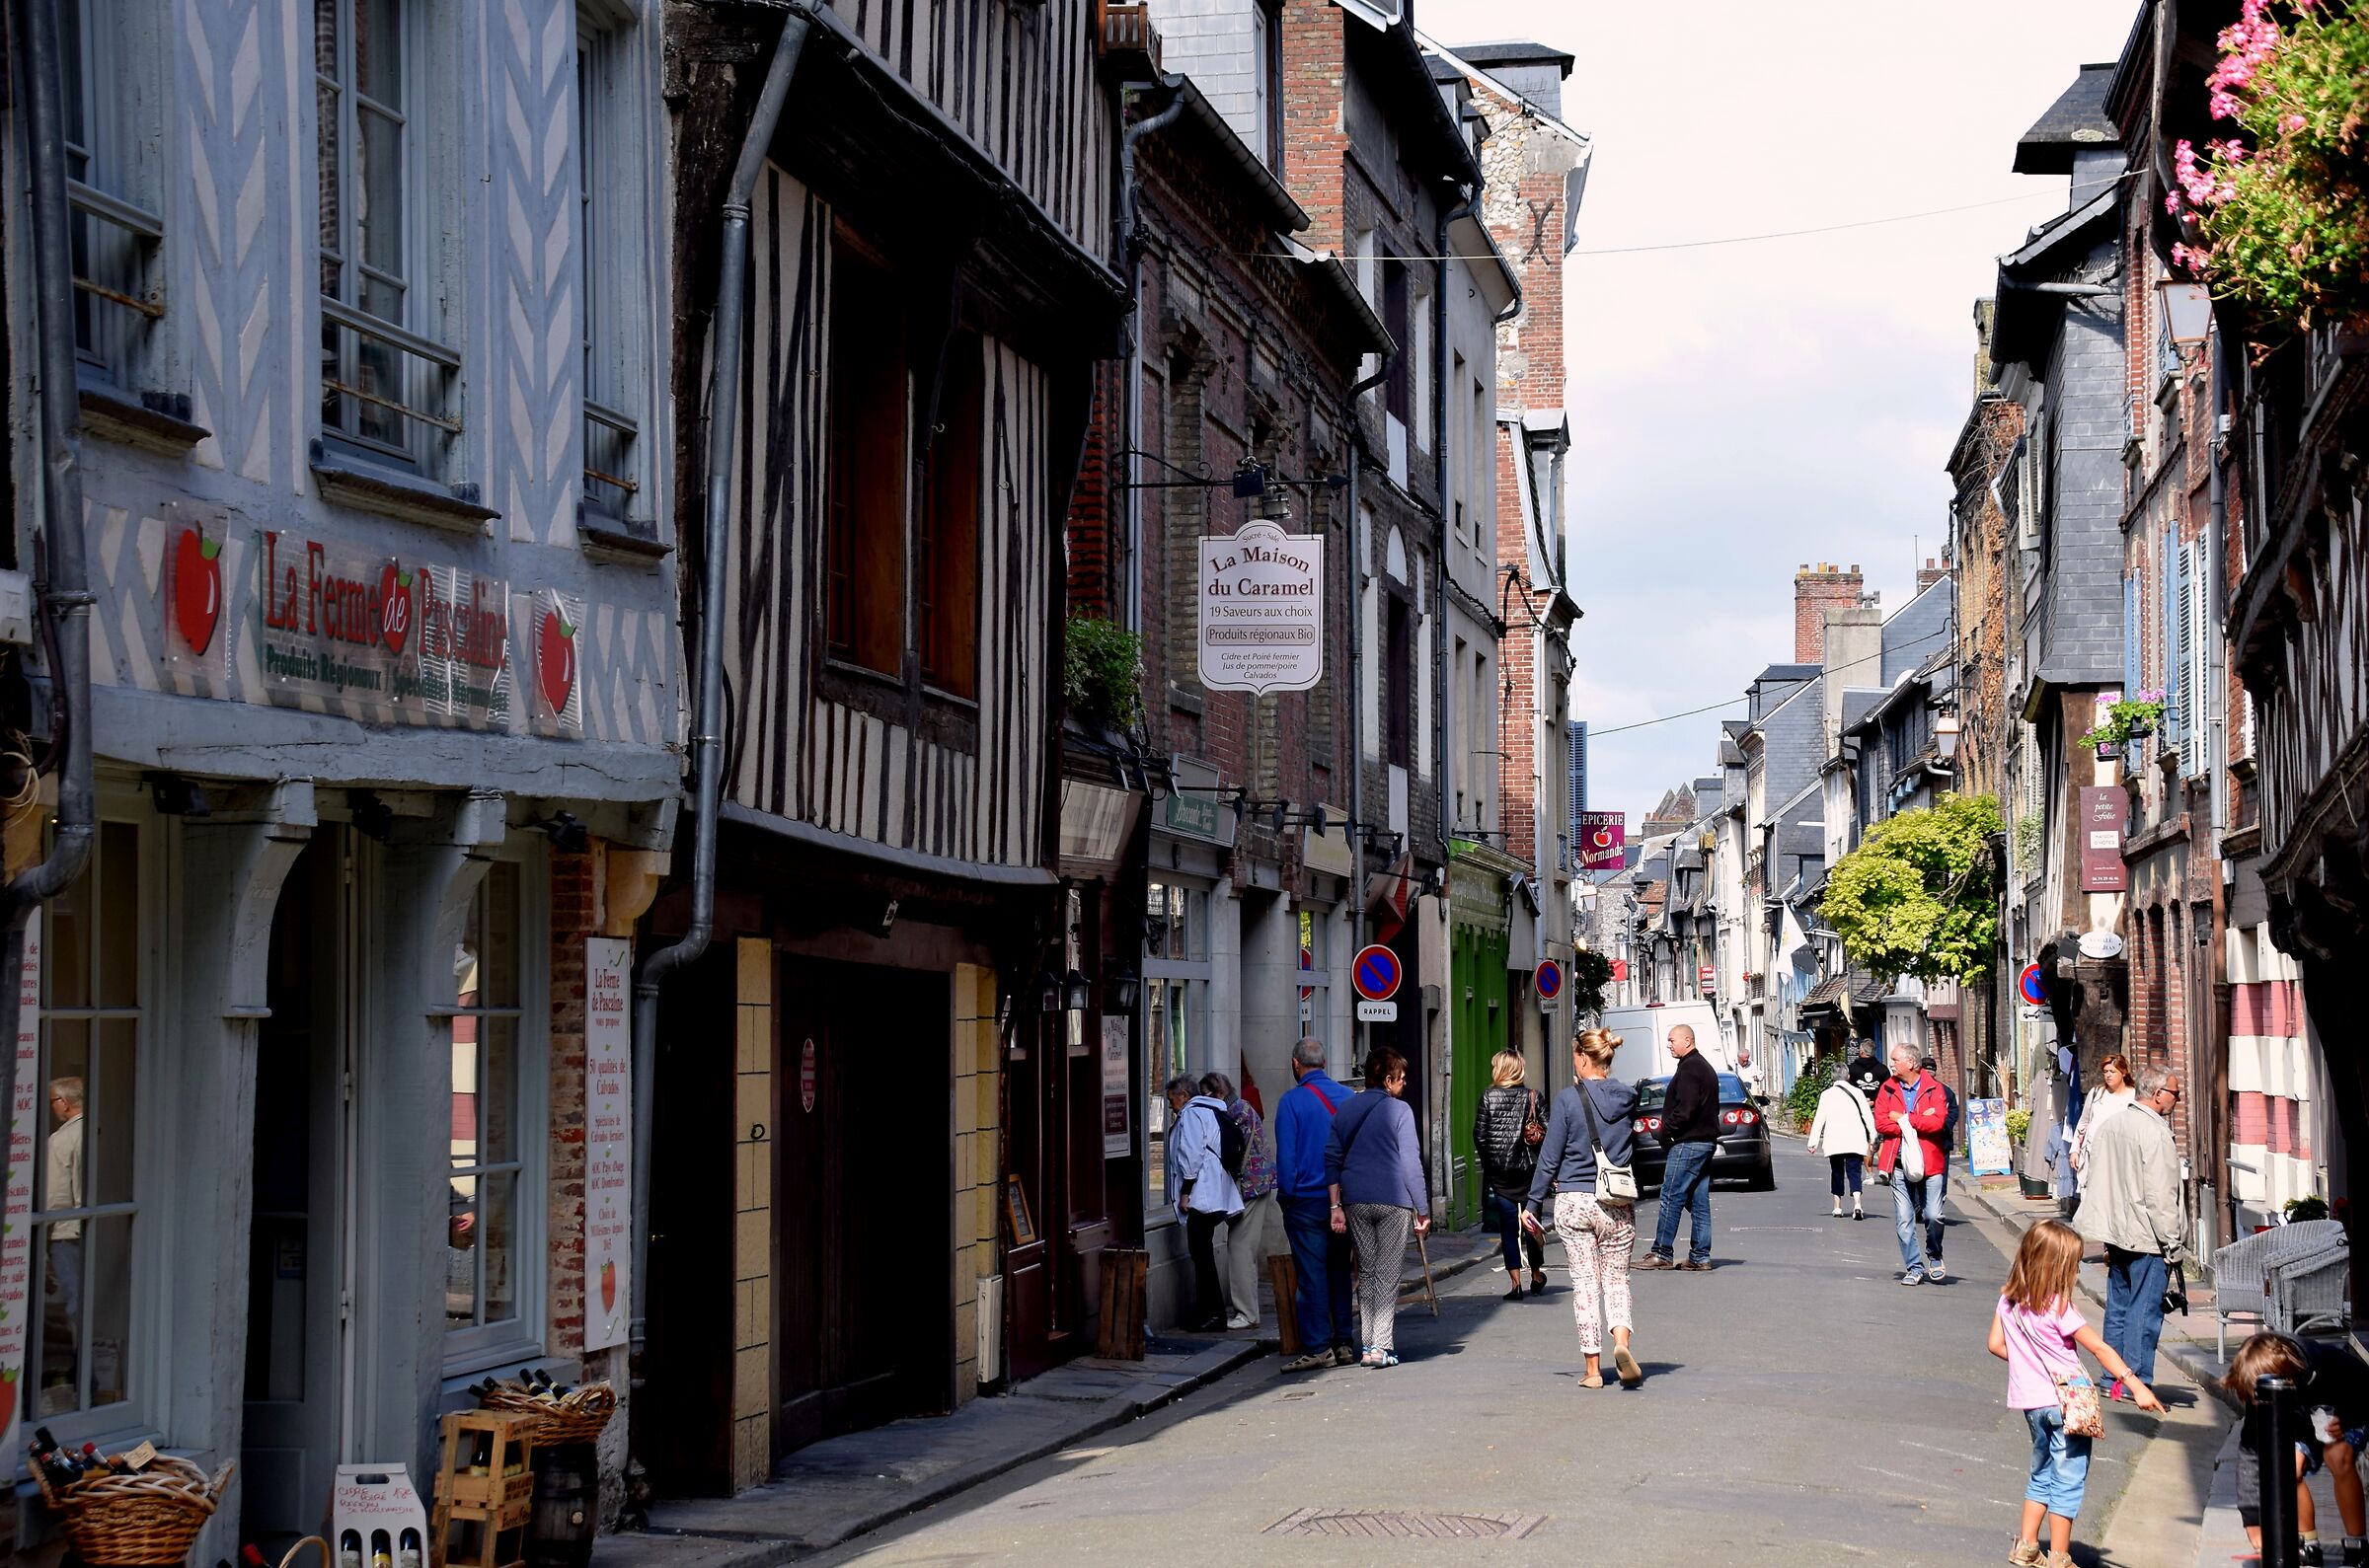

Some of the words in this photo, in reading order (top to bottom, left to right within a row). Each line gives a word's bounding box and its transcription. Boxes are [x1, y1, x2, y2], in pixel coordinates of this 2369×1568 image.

[1243, 532, 1261, 543] Sucré
[1266, 532, 1280, 543] Salé
[1209, 555, 1236, 573] La
[1241, 546, 1310, 573] Maison
[1208, 578, 1231, 596] du
[1238, 578, 1314, 596] Caramel
[265, 531, 299, 633] La
[307, 541, 379, 647] Ferme
[384, 577, 407, 634] de
[419, 568, 507, 669] Pascaline
[1209, 606, 1221, 617] 19
[1223, 606, 1261, 617] Saveurs
[1264, 608, 1282, 617] aux
[1284, 605, 1313, 617] choix
[1209, 629, 1248, 639] Produits
[1250, 629, 1295, 643] régionaux
[1298, 629, 1313, 639] Bio
[267, 643, 317, 681] Produits
[1253, 652, 1271, 661] Poiré
[1272, 652, 1300, 662] fermier
[1222, 662, 1234, 671] Jus
[1247, 662, 1298, 672] pomme/poire
[1582, 815, 1624, 825] EPICERIE
[1581, 842, 1624, 865] Normande
[595, 968, 603, 988] La
[603, 968, 620, 988] Ferme
[591, 992, 598, 1011] de
[599, 992, 624, 1011] Pascaline
[339, 1487, 368, 1497] CIDRE
